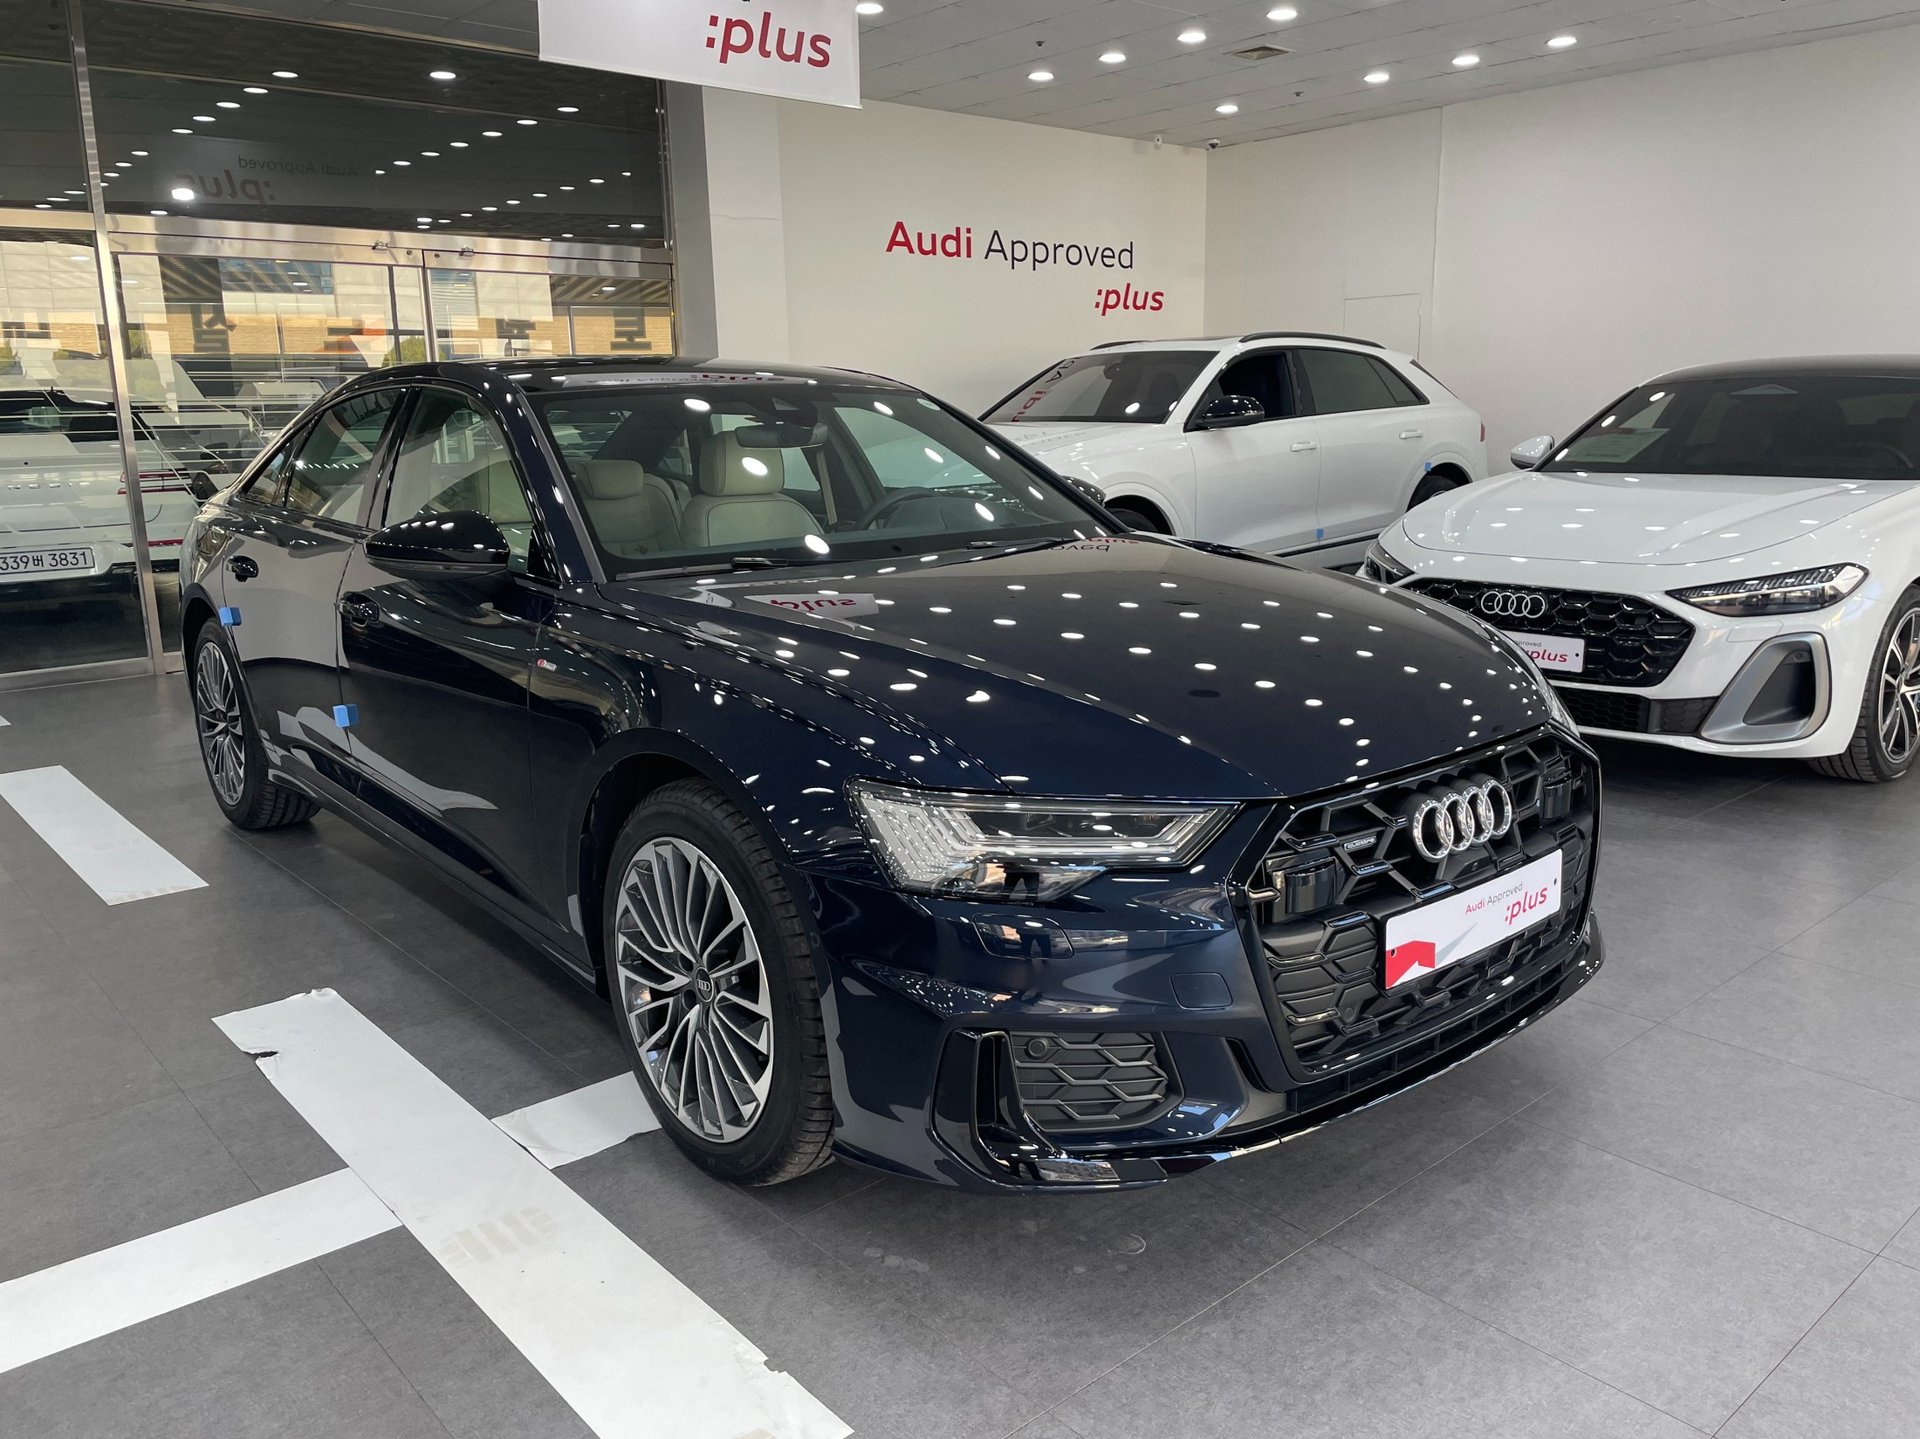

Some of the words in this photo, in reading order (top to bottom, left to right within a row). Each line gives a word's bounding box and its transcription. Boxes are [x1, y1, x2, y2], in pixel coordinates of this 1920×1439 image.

[706, 11, 831, 68] :plus
[885, 221, 972, 258] Audi
[984, 229, 1134, 271] Approved
[1094, 282, 1164, 316] :plus
[48, 551, 87, 567] 3831
[1465, 898, 1486, 914] Audi
[1486, 882, 1523, 906] Approved
[1504, 886, 1548, 926] :plus
